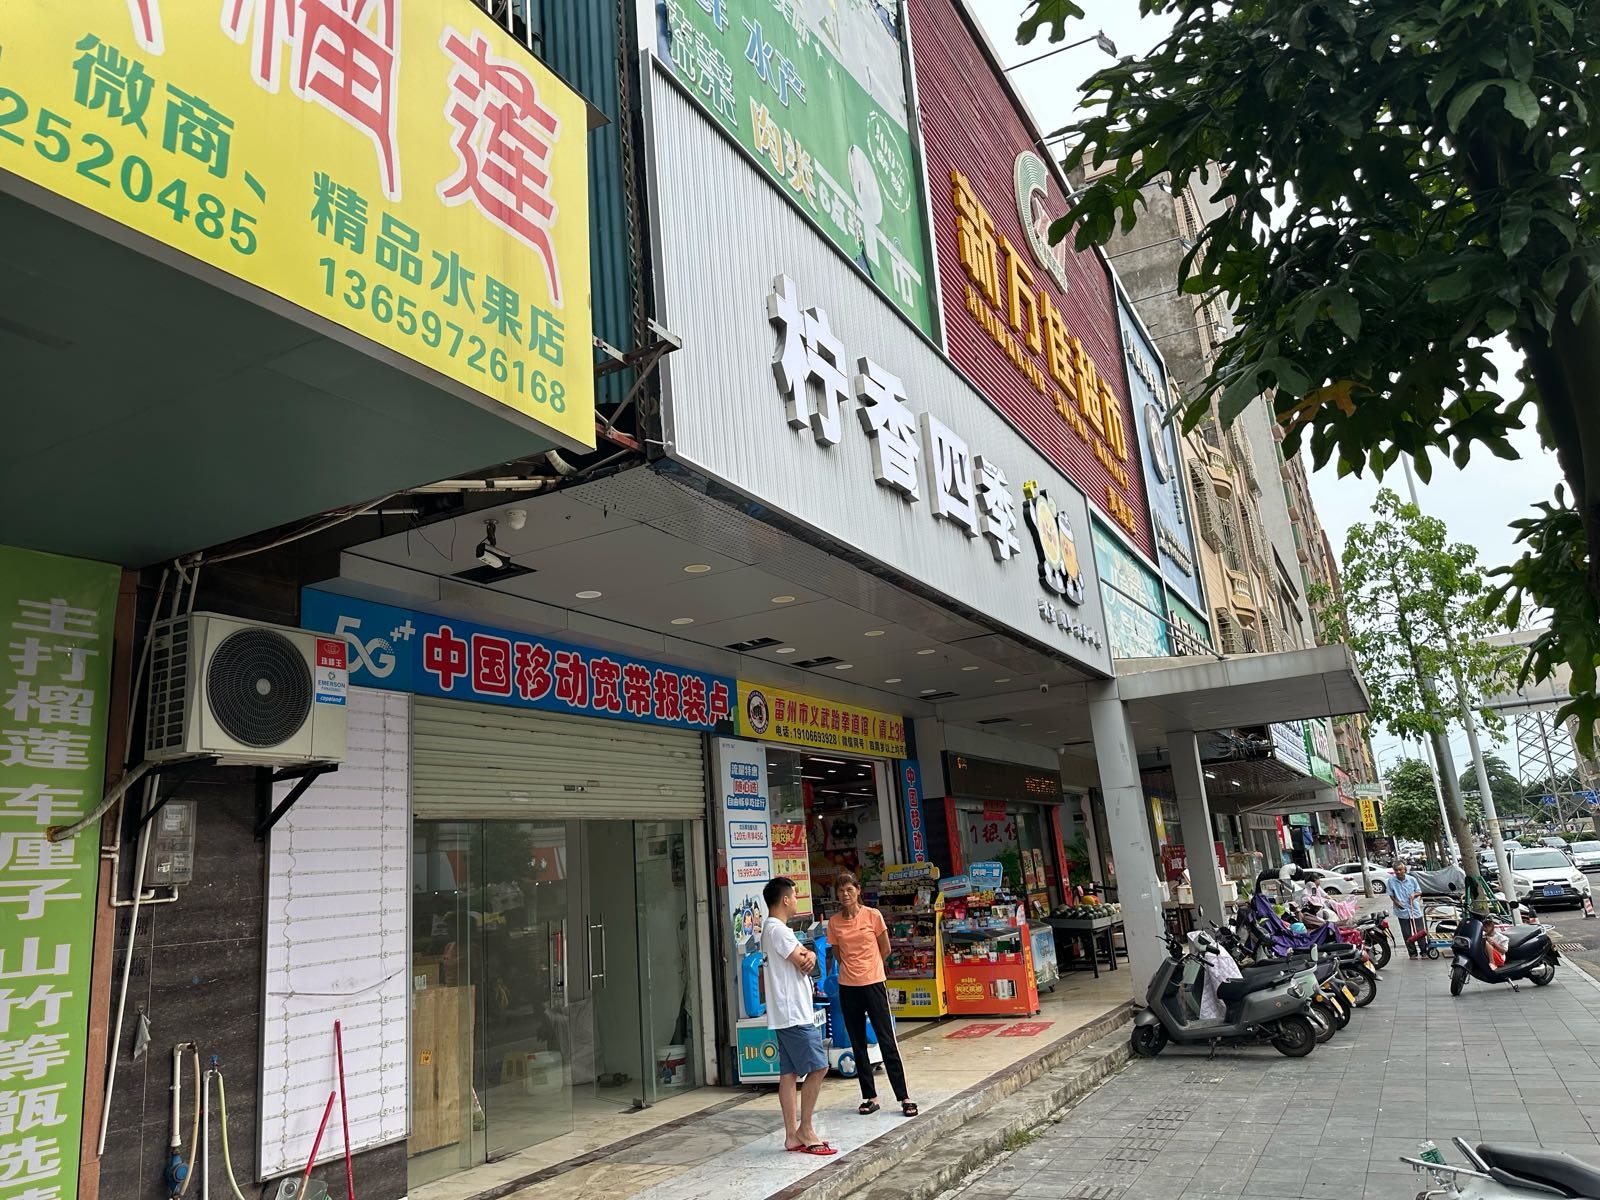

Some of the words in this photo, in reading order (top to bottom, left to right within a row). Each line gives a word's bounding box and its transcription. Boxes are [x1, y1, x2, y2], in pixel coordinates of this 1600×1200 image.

[742, 16, 806, 107] 水产
[310, 170, 566, 368] 精品水果店
[318, 257, 567, 414] 13659726168
[951, 168, 1128, 464] 新万佳超市
[766, 273, 1020, 562] 柠香四季
[318, 680, 346, 688] EMERSON
[422, 624, 730, 726] 中国移动宽带报装点
